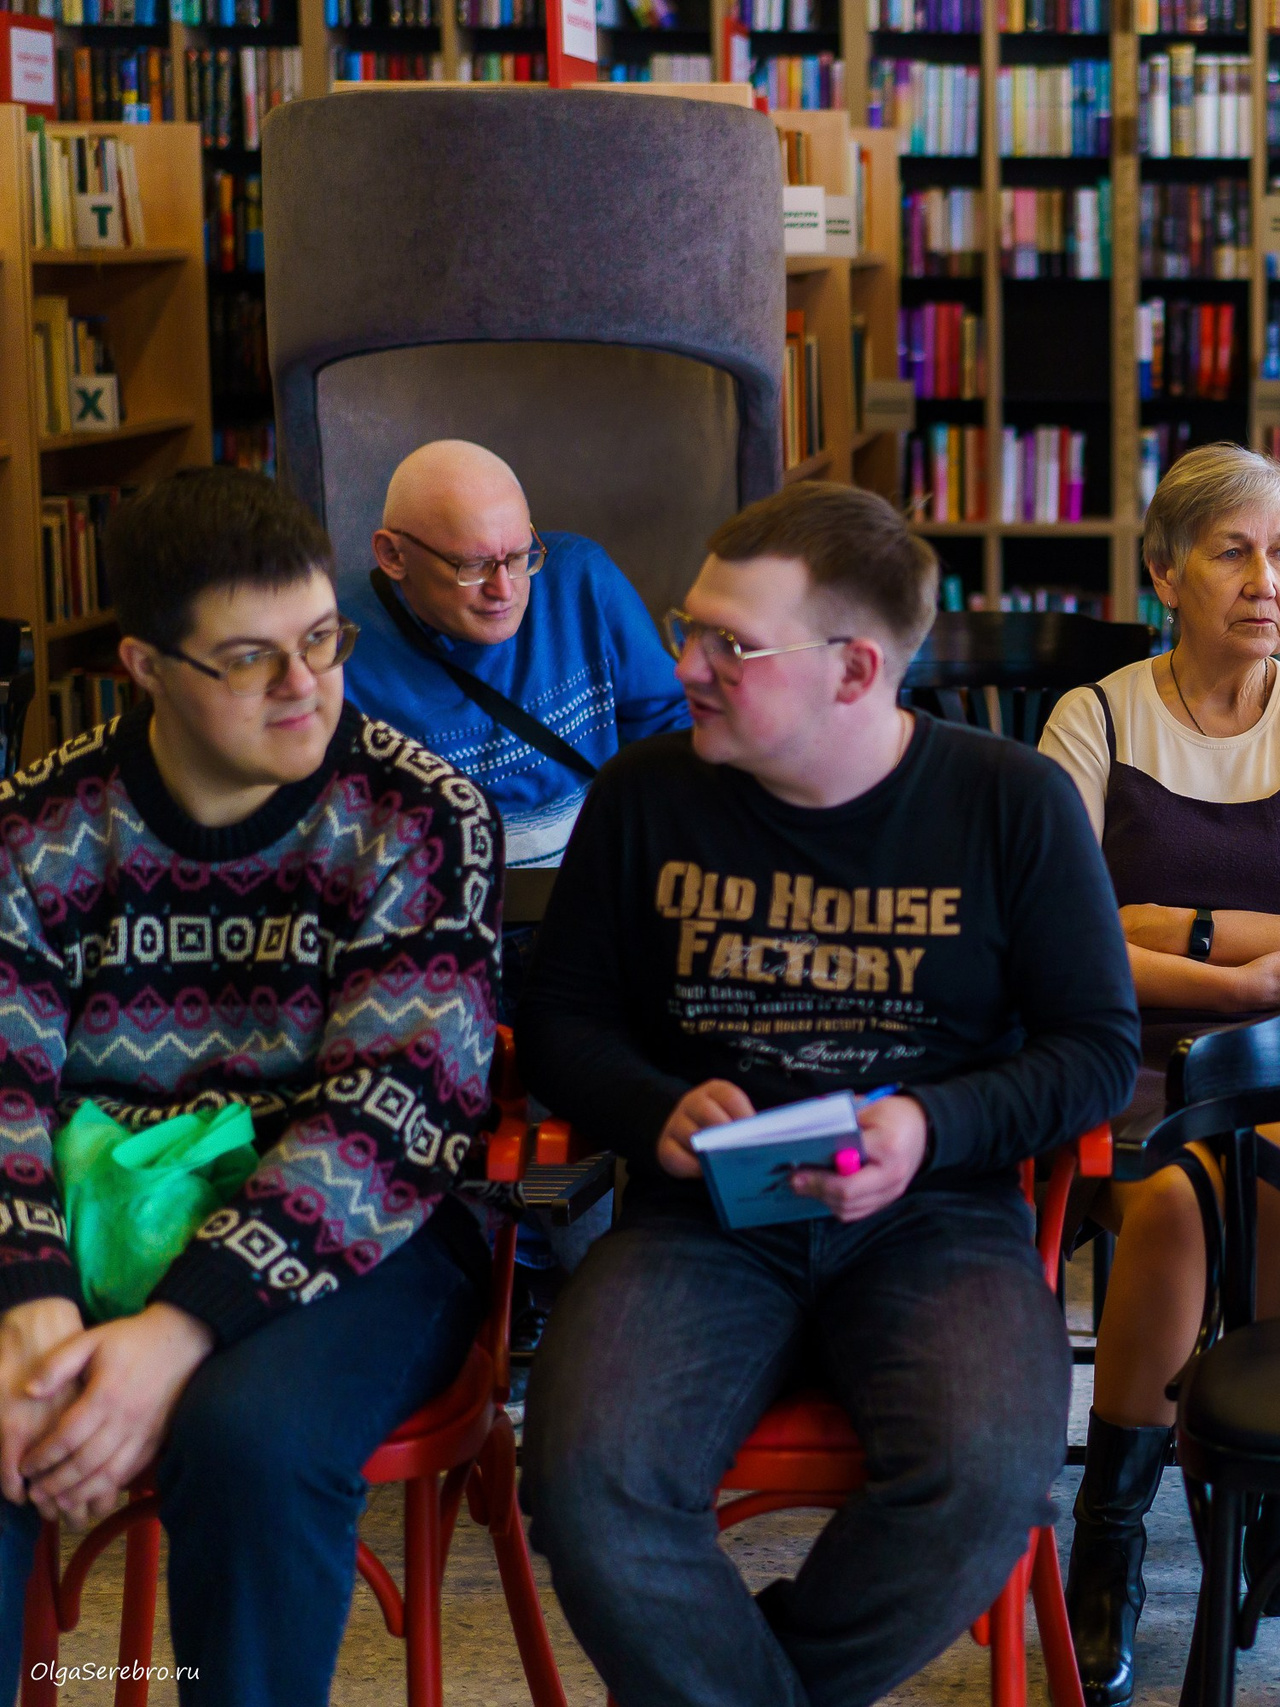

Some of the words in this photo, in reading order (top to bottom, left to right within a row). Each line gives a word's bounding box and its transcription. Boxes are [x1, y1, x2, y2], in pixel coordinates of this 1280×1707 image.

[655, 860, 757, 922] OLD
[768, 871, 962, 936] HOUSE
[676, 918, 926, 994] FACTORY
